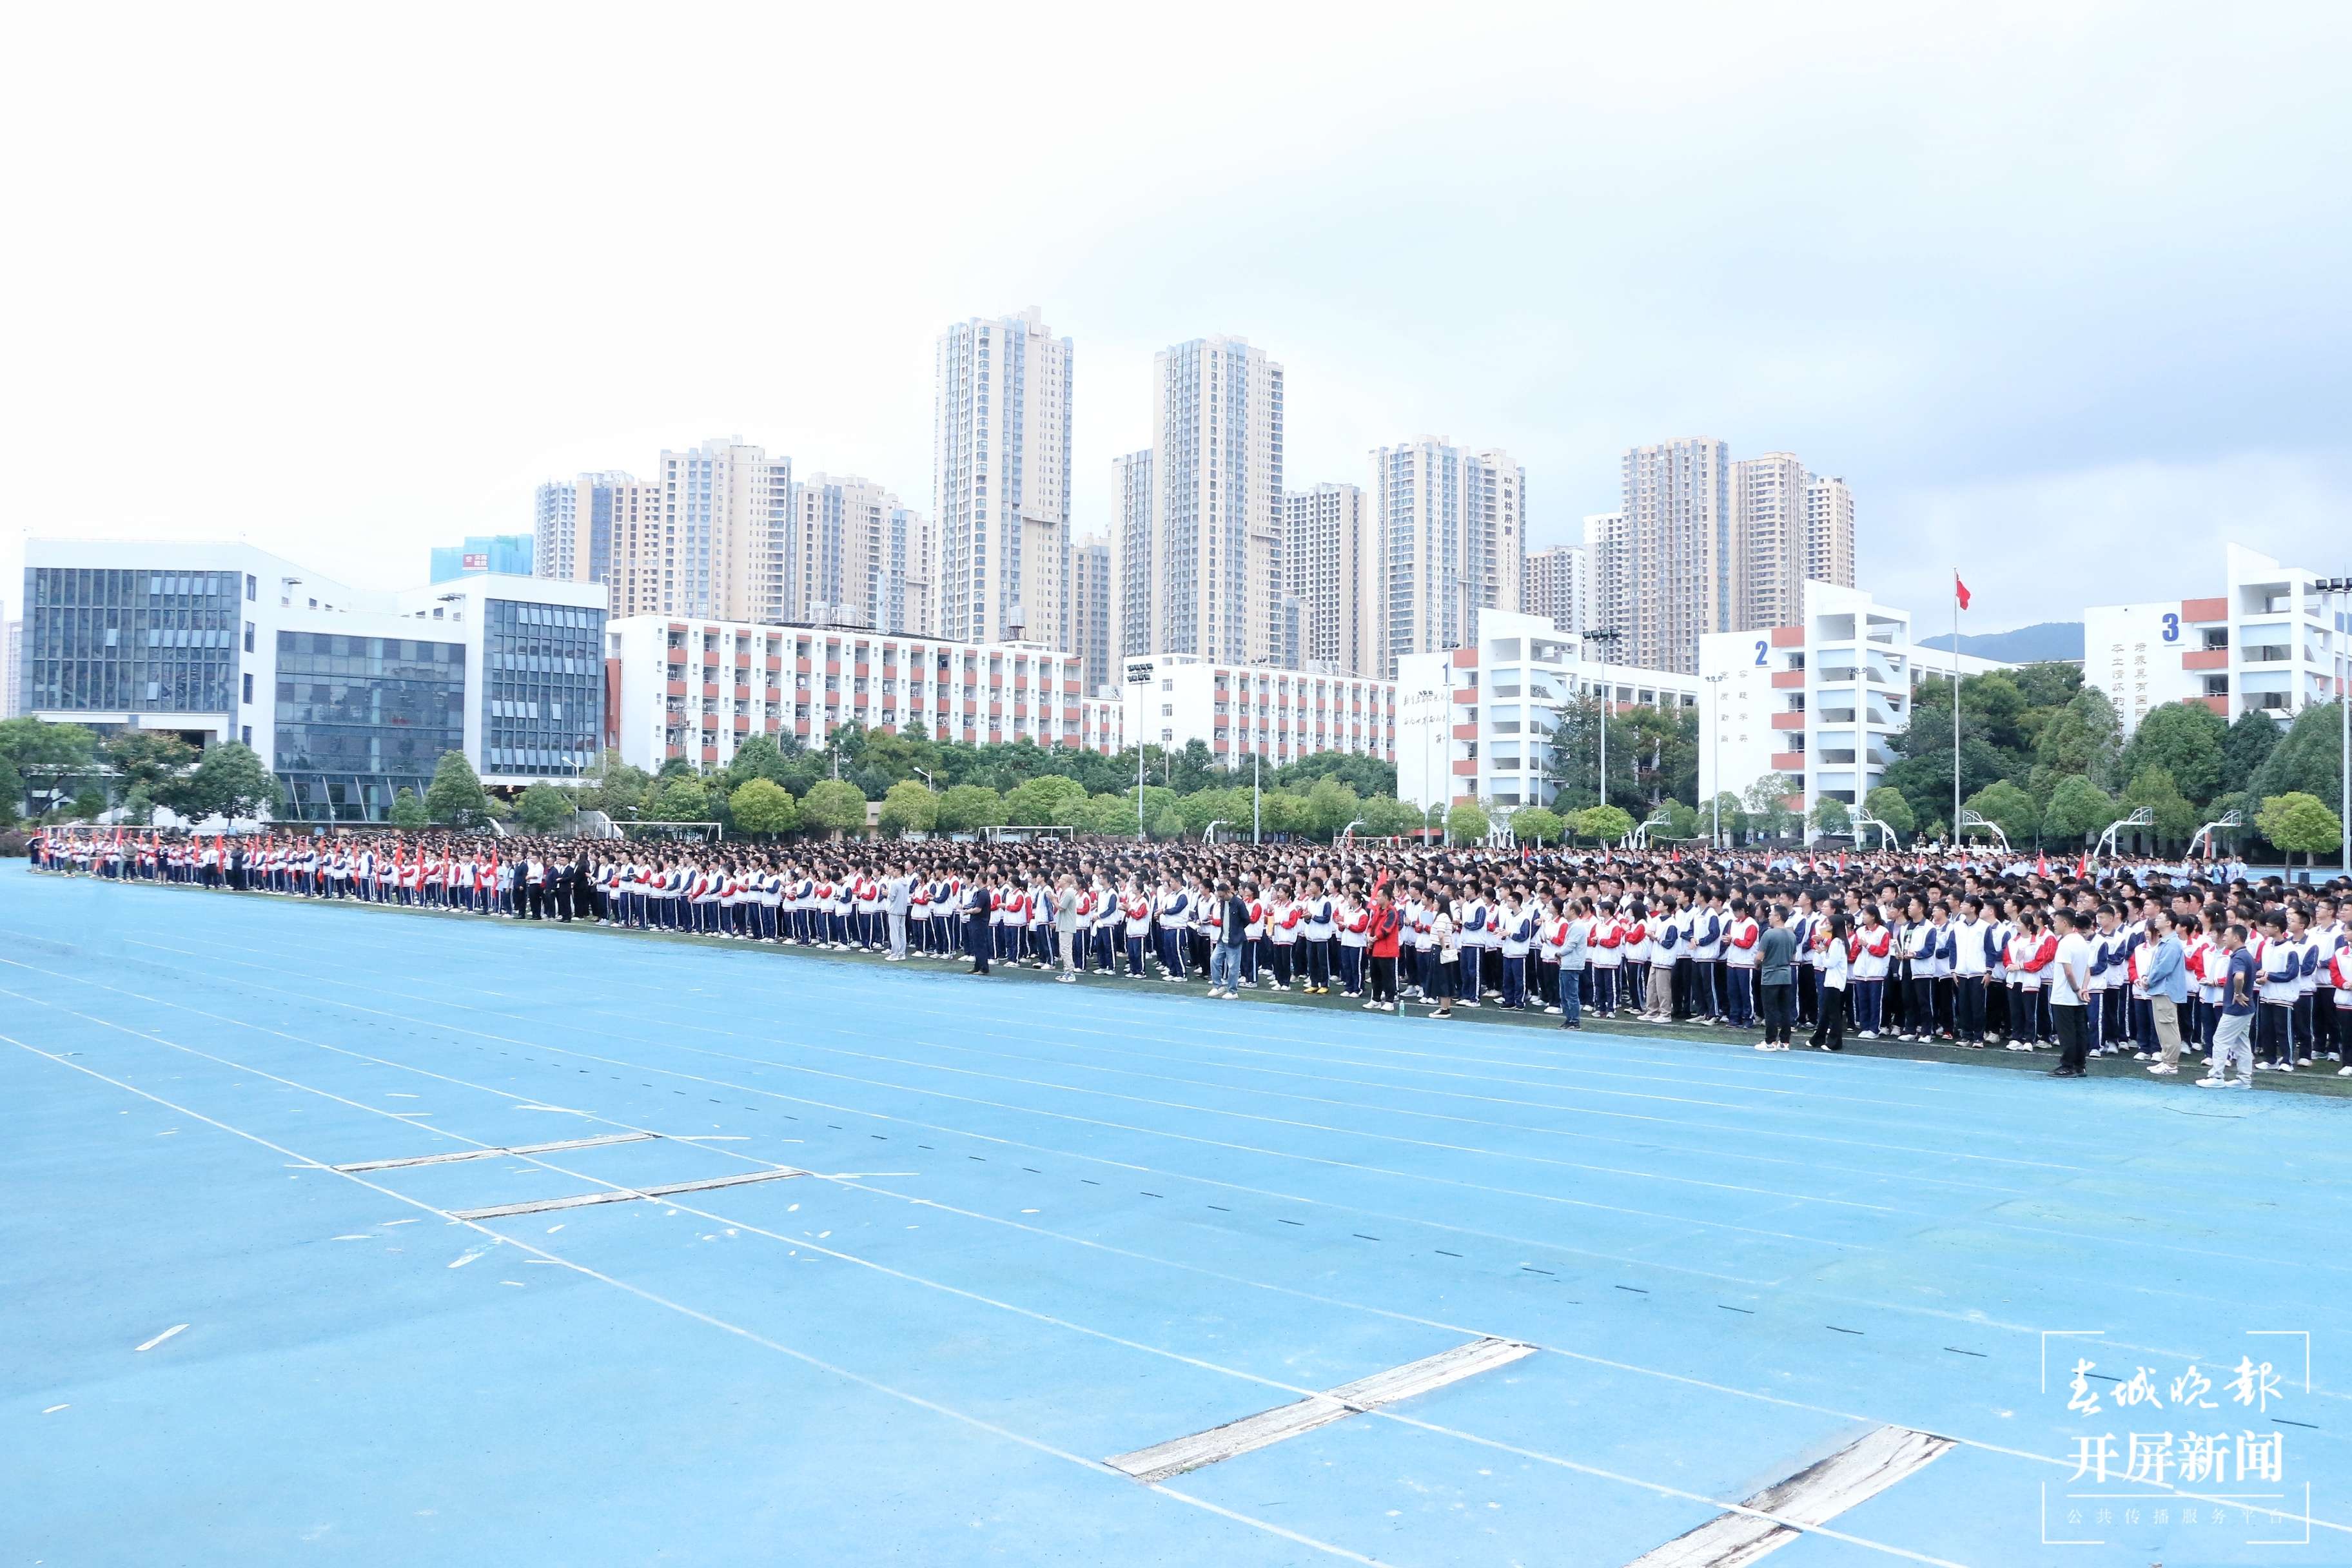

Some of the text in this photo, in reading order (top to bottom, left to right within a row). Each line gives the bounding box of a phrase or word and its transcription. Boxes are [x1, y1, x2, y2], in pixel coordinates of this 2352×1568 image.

[2162, 612, 2179, 642] 3
[1755, 640, 1768, 665] 2
[1442, 662, 1448, 683] 1
